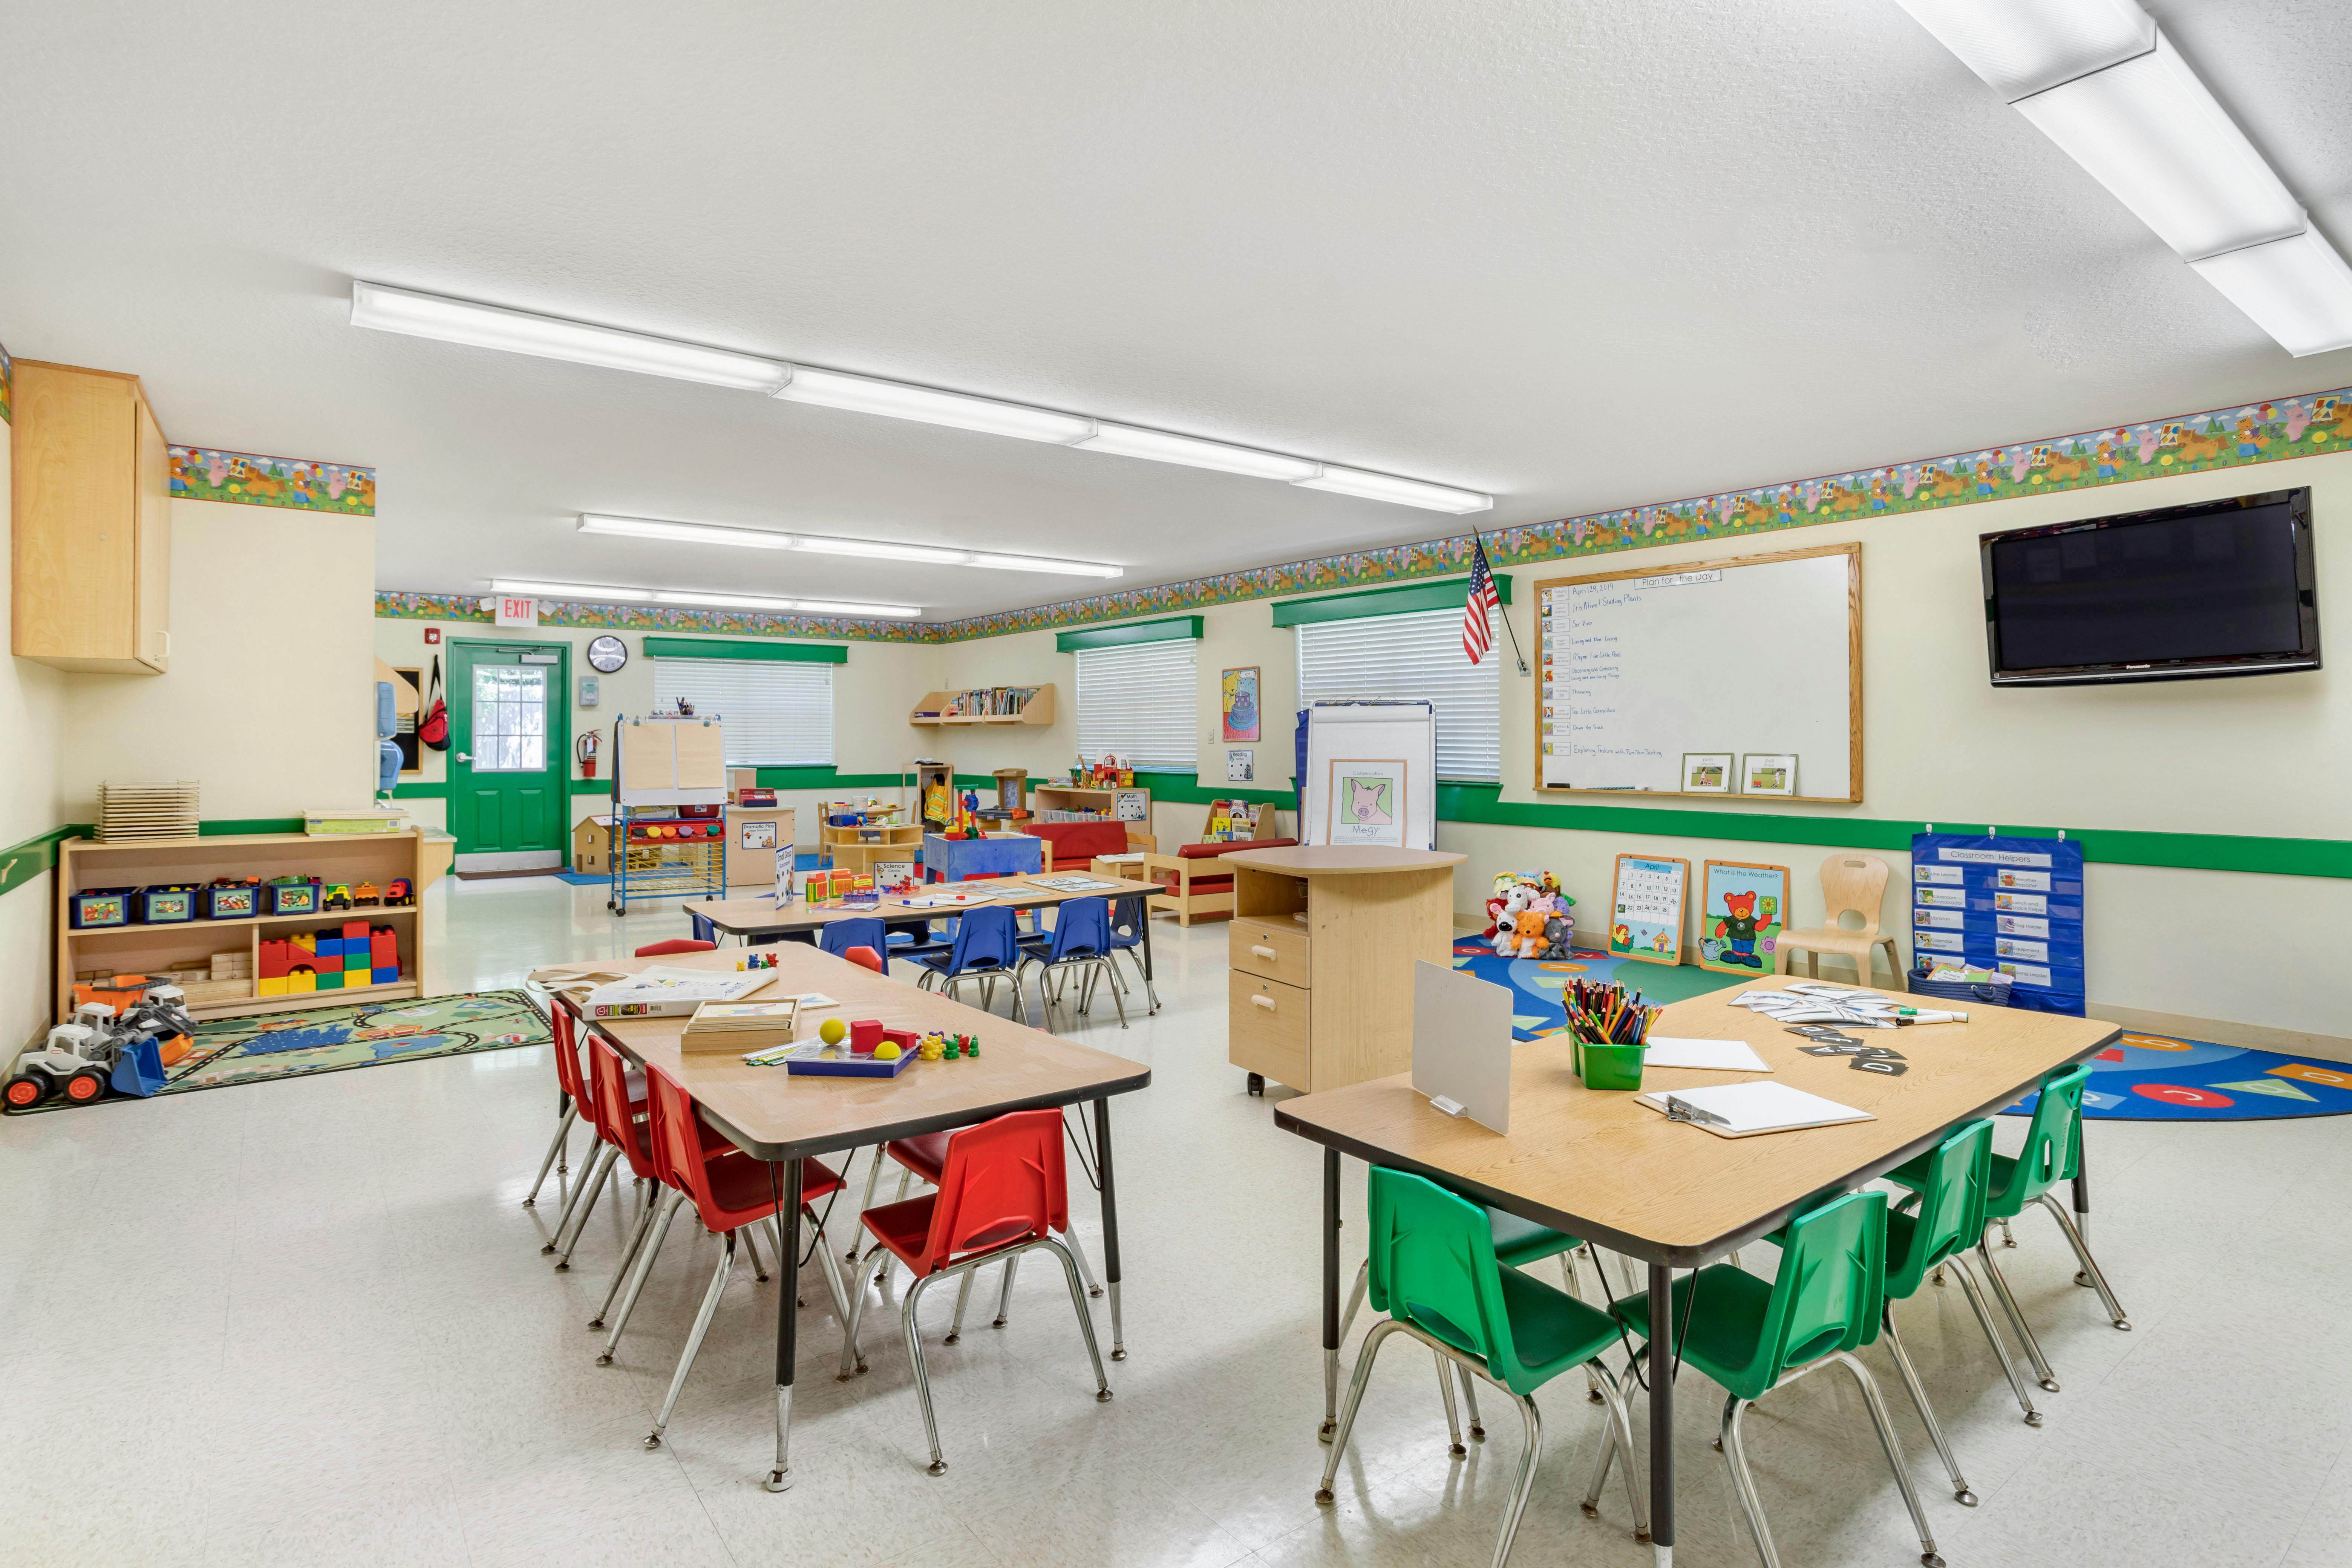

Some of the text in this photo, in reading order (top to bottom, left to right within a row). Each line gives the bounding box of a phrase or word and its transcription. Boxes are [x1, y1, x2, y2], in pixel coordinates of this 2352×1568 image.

[1573, 586, 1589, 597] April
[1600, 583, 1613, 591] 2019
[504, 599, 531, 619] EXIT
[1573, 603, 1582, 612] It's
[1623, 594, 1642, 602] Plants
[1574, 745, 1596, 756] Exploring
[1597, 745, 1613, 754] Texture
[1645, 749, 1662, 757] Painting
[1951, 851, 2030, 863] Classroom Helpers
